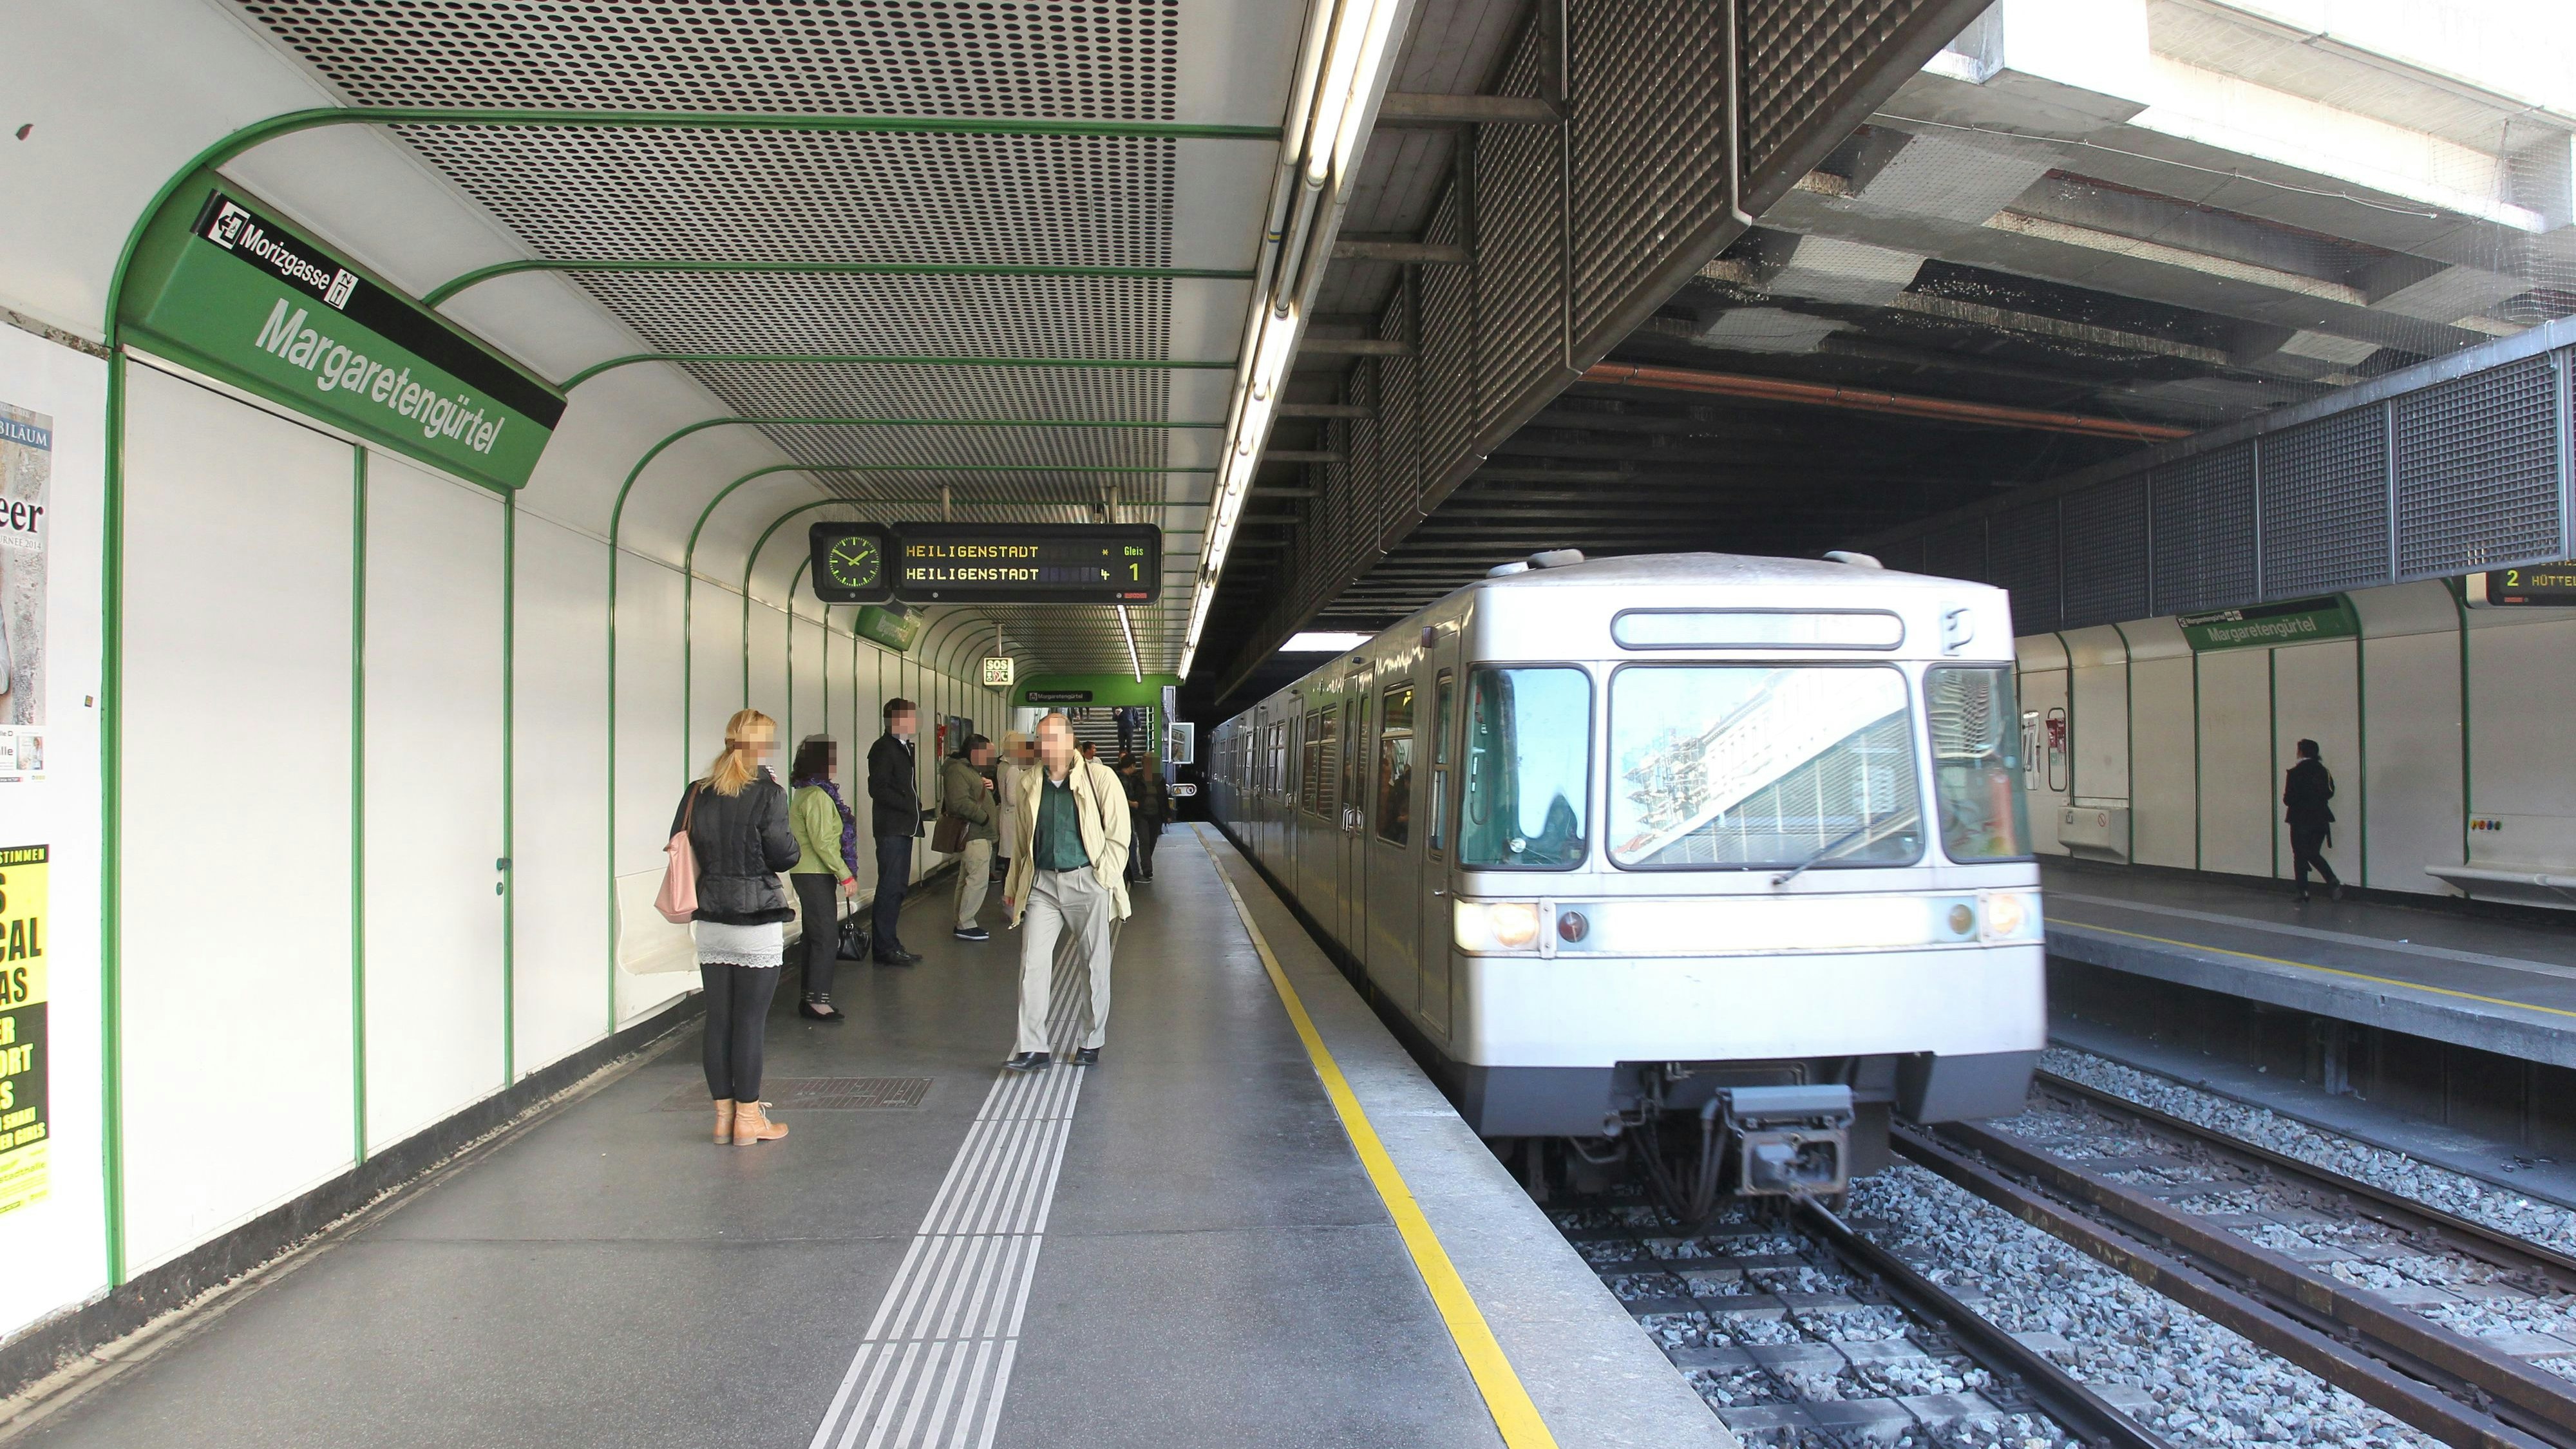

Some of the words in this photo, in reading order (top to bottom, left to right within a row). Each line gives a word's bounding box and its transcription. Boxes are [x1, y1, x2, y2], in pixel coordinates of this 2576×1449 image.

[239, 223, 330, 290] Morizgasse
[255, 298, 506, 455] Margaretengürtel
[25, 540, 41, 549] 2014
[1124, 546, 1143, 556] Gleis
[906, 545, 1038, 558] HEILIGENSTADT
[906, 568, 1039, 580] HEILIGENSTADT
[1101, 569, 1110, 580] 4
[1129, 563, 1138, 581] 1
[2506, 569, 2519, 587] 2
[2207, 616, 2317, 642] Margaretengürtel
[986, 659, 1008, 670] SOS
[0, 746, 13, 755] lle
